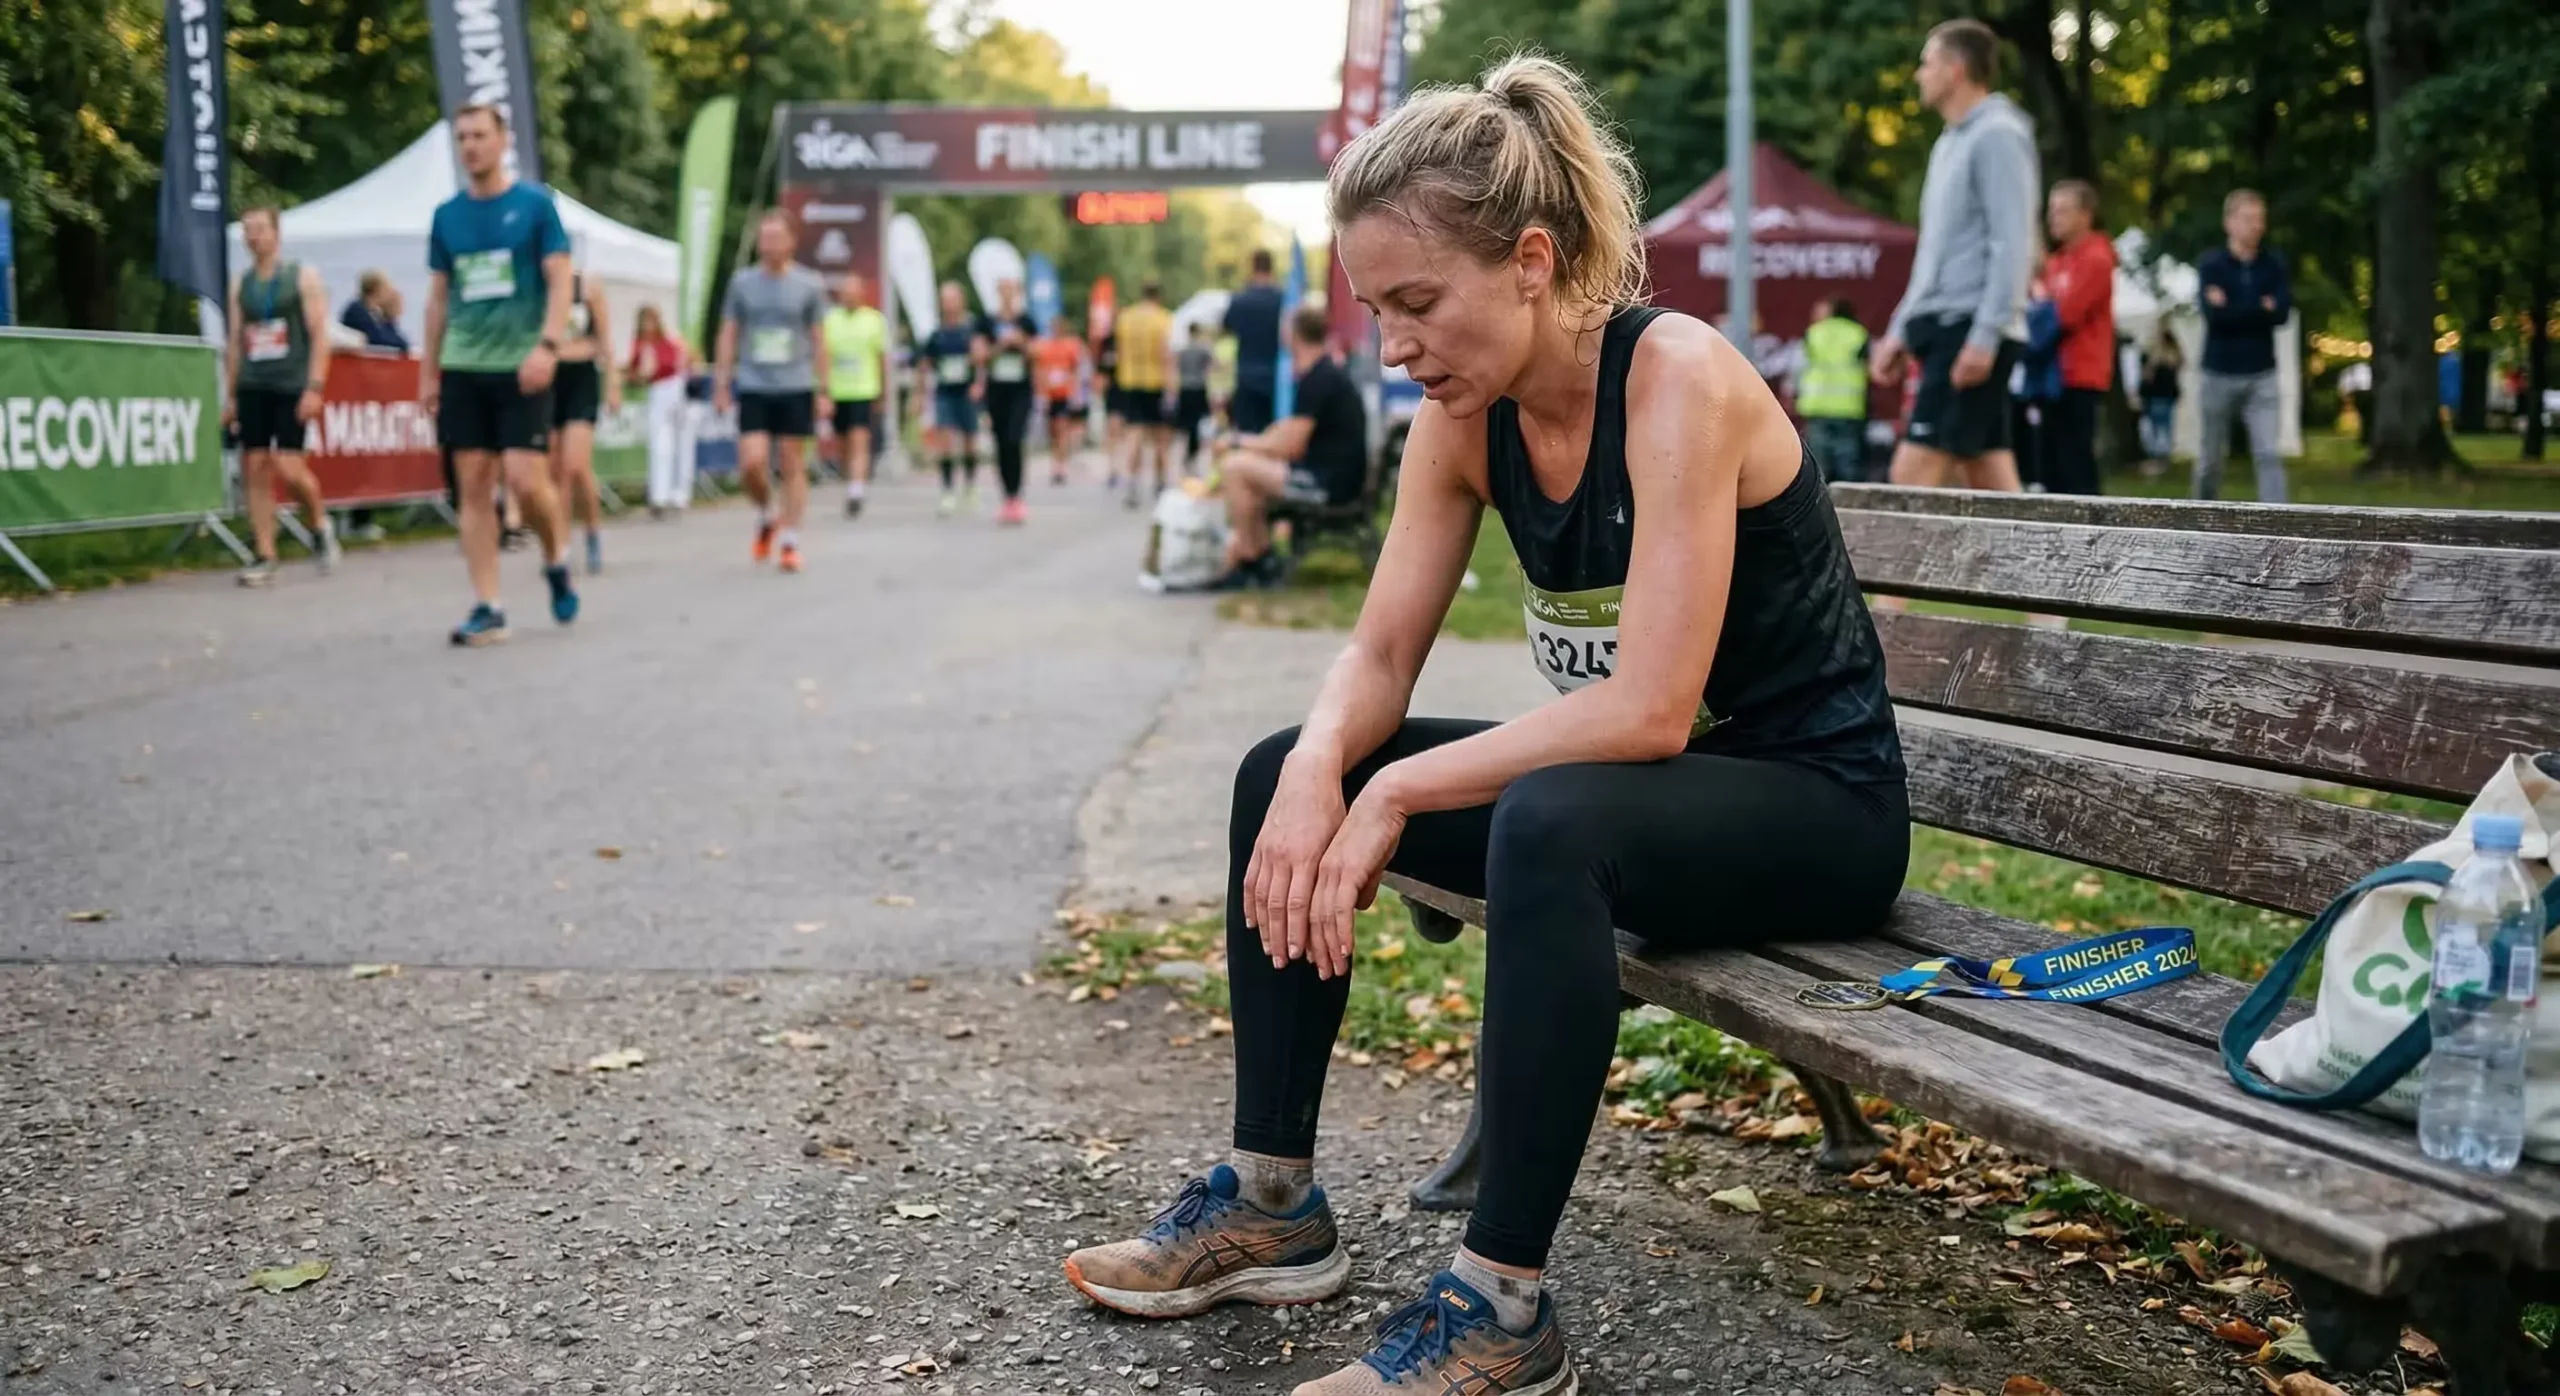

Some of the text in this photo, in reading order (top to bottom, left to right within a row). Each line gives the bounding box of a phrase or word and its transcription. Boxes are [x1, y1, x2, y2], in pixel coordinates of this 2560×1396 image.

[975, 122, 1140, 170] FINISH
[1147, 122, 1264, 169] LINE
[0, 396, 202, 471] ECOVERY
[1600, 601, 1623, 614] FIN
[2044, 937, 2146, 976] FINISHER
[2048, 960, 2153, 1000] FINISHER
